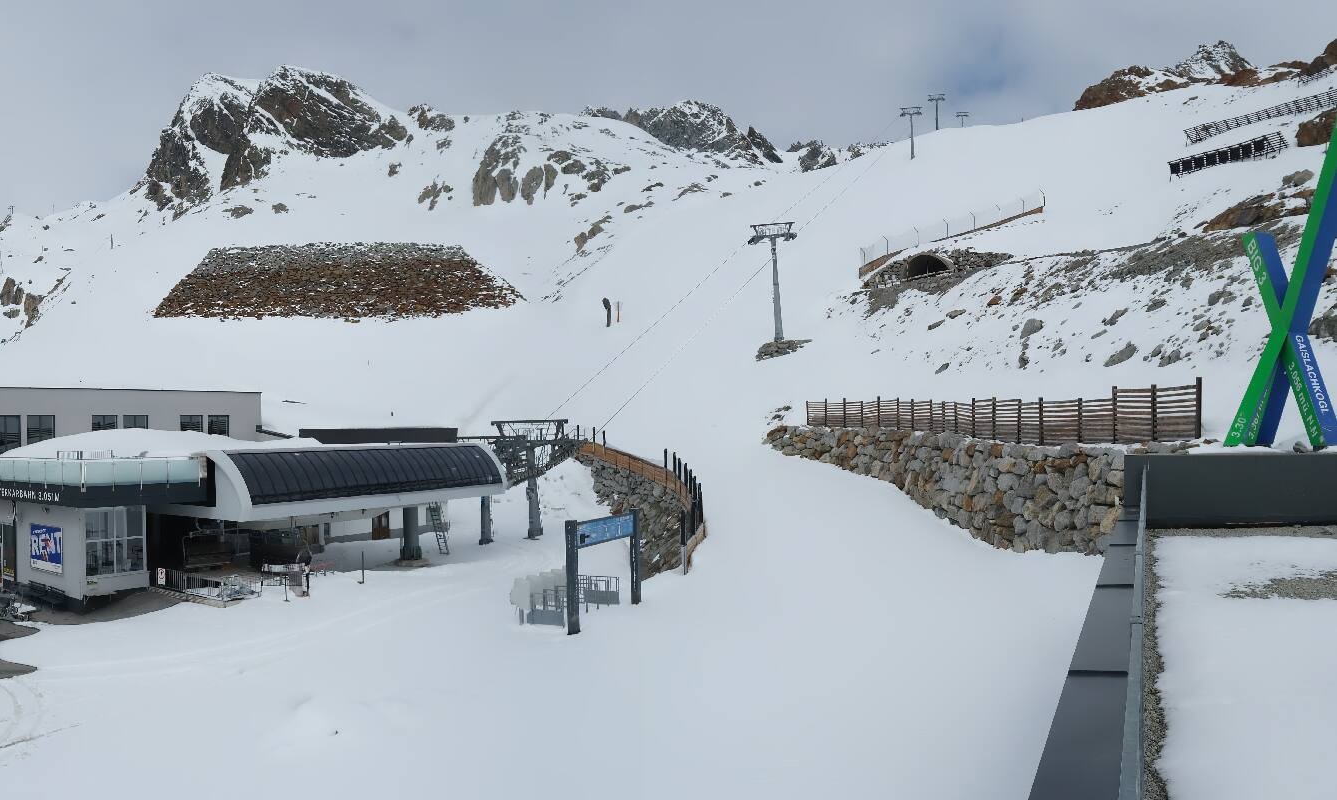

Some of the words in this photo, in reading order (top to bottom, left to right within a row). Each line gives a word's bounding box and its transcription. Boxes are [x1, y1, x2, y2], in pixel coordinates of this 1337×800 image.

[1248, 238, 1261, 271] BIG
[1259, 272, 1266, 285] 3
[1288, 361, 1303, 391] 3.056
[1295, 335, 1329, 415] GAISLACHKOGL
[1231, 412, 1247, 438] 3.30
[31, 532, 62, 555] RENT
